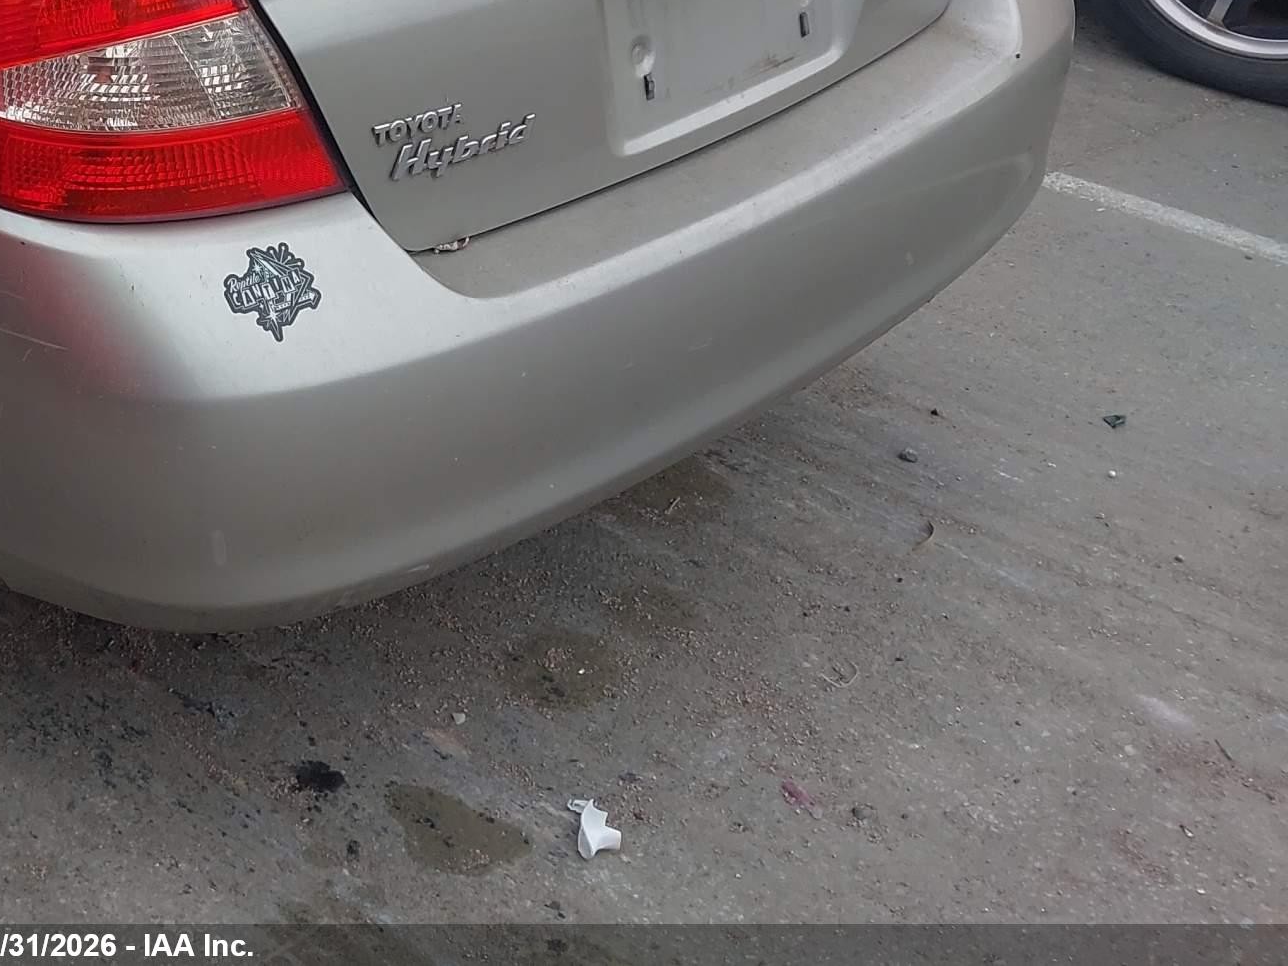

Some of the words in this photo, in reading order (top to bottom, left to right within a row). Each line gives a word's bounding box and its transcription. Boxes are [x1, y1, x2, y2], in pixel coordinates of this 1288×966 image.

[372, 103, 463, 147] TOYOTA
[389, 113, 536, 181] Hybrid
[231, 270, 302, 308] CANTINA
